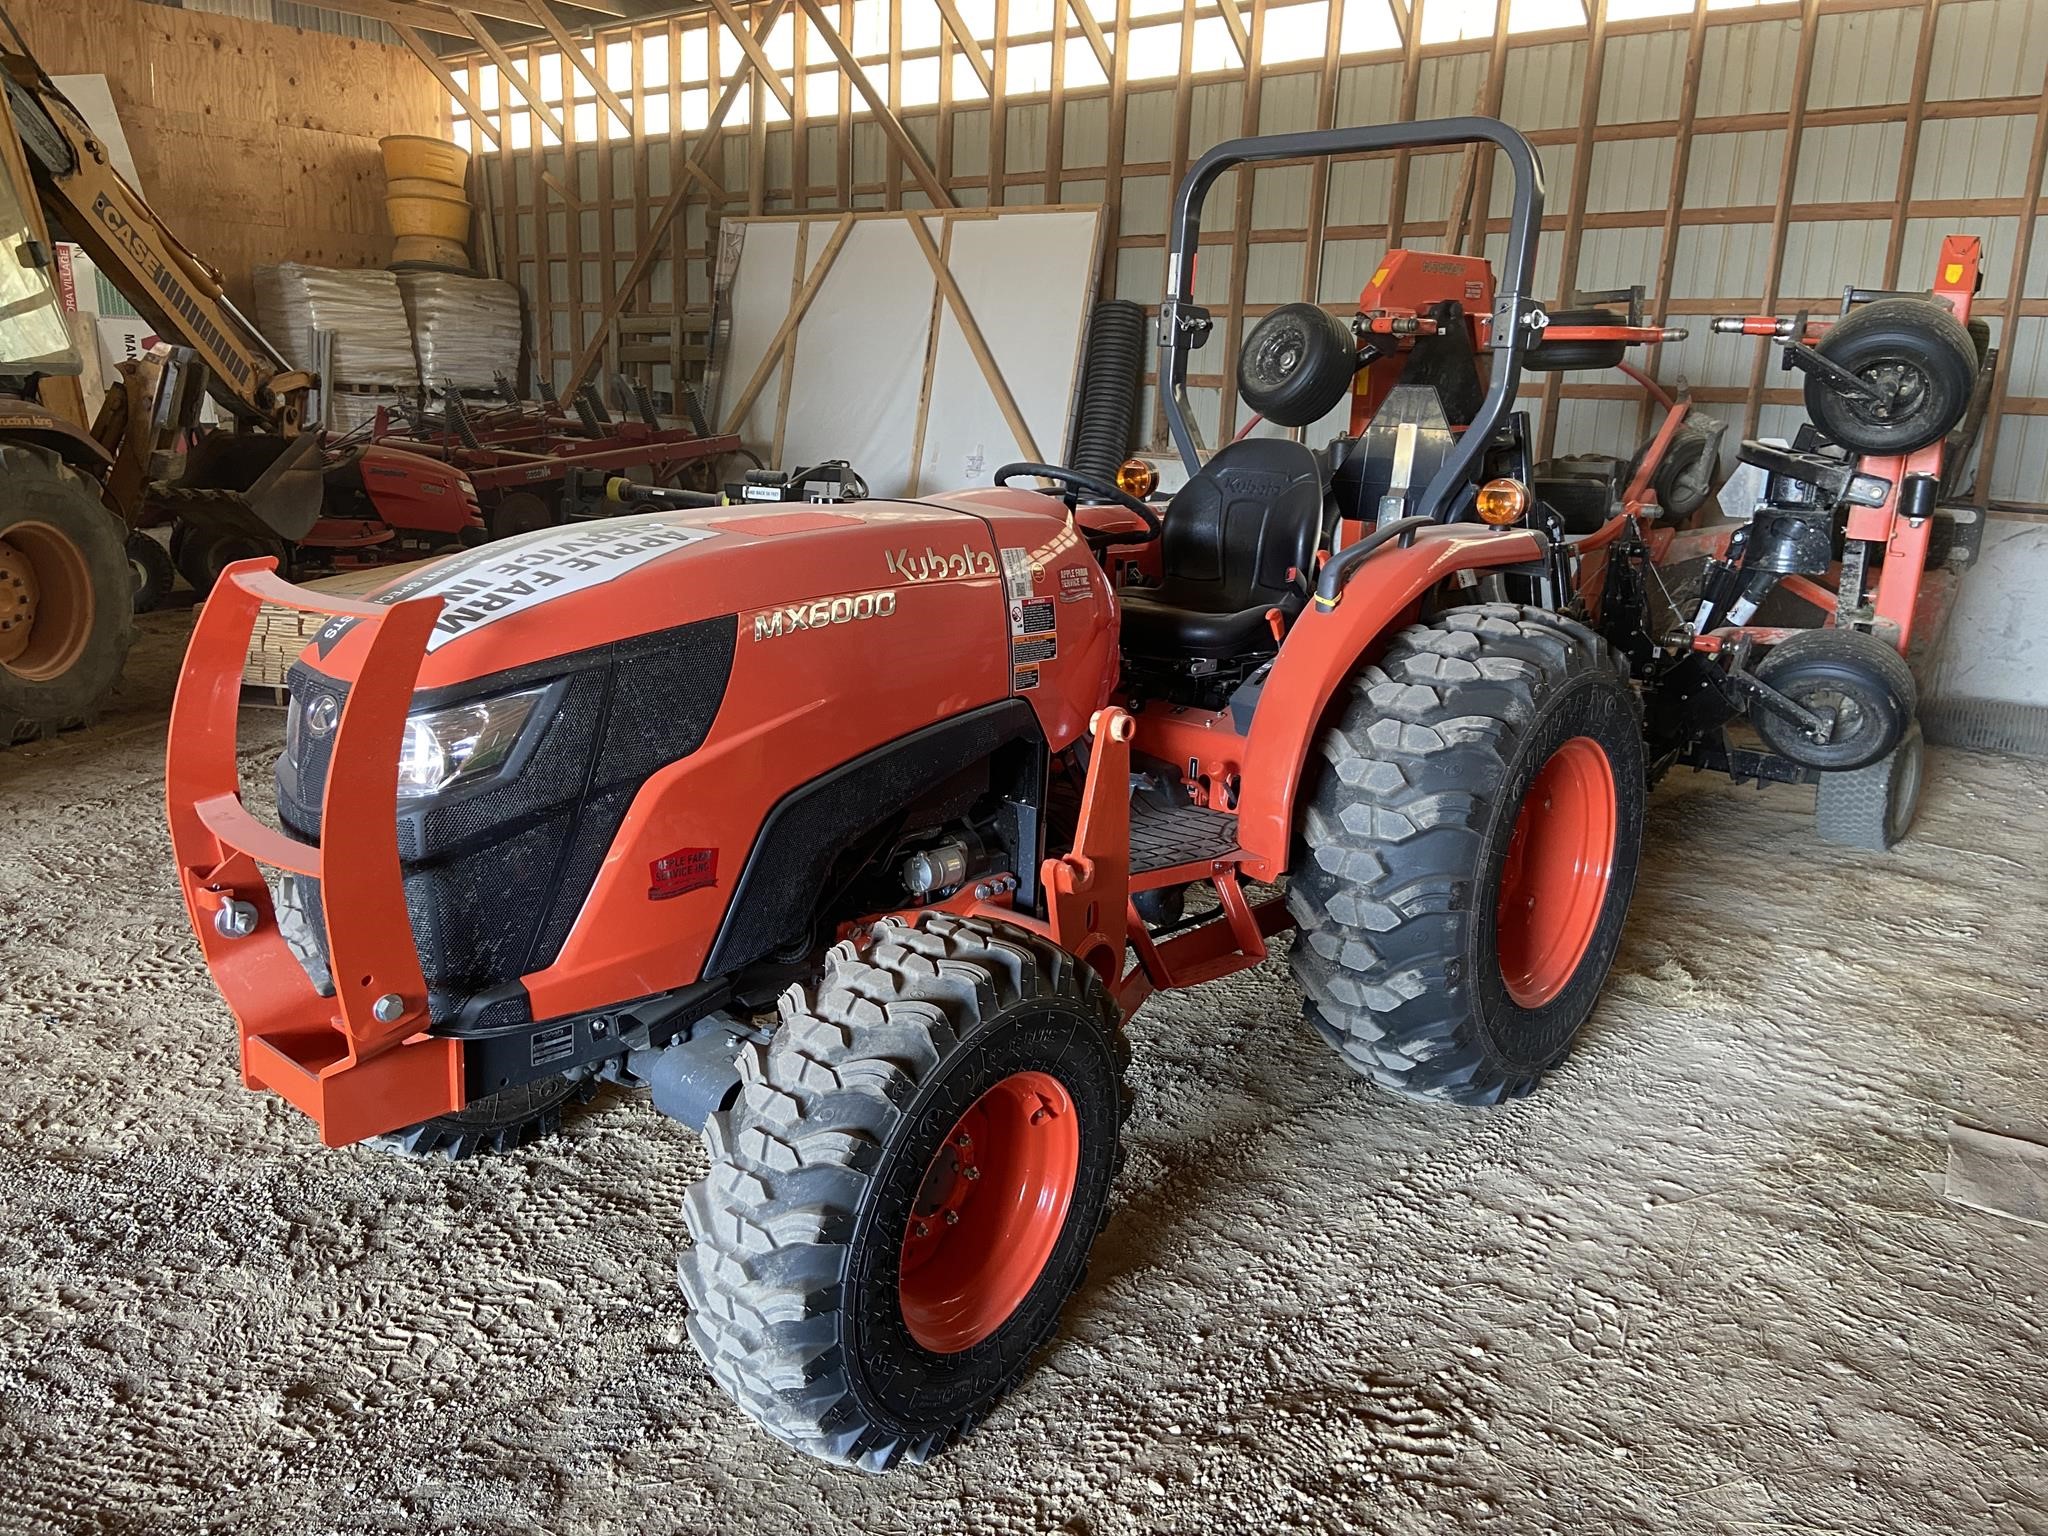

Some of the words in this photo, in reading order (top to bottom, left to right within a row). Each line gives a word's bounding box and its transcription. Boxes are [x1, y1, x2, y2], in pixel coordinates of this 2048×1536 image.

[103, 205, 162, 276] CASE
[60, 249, 73, 292] VILLAGE
[1225, 477, 1280, 496] Kubota
[487, 523, 664, 577] SERVICE
[556, 530, 689, 572] APPLE
[885, 544, 996, 581] Kubota
[437, 570, 566, 635] FARM
[438, 578, 494, 606] IN
[754, 592, 896, 642] MX6000
[656, 856, 686, 870] APPLE
[656, 865, 693, 881] SERVICE
